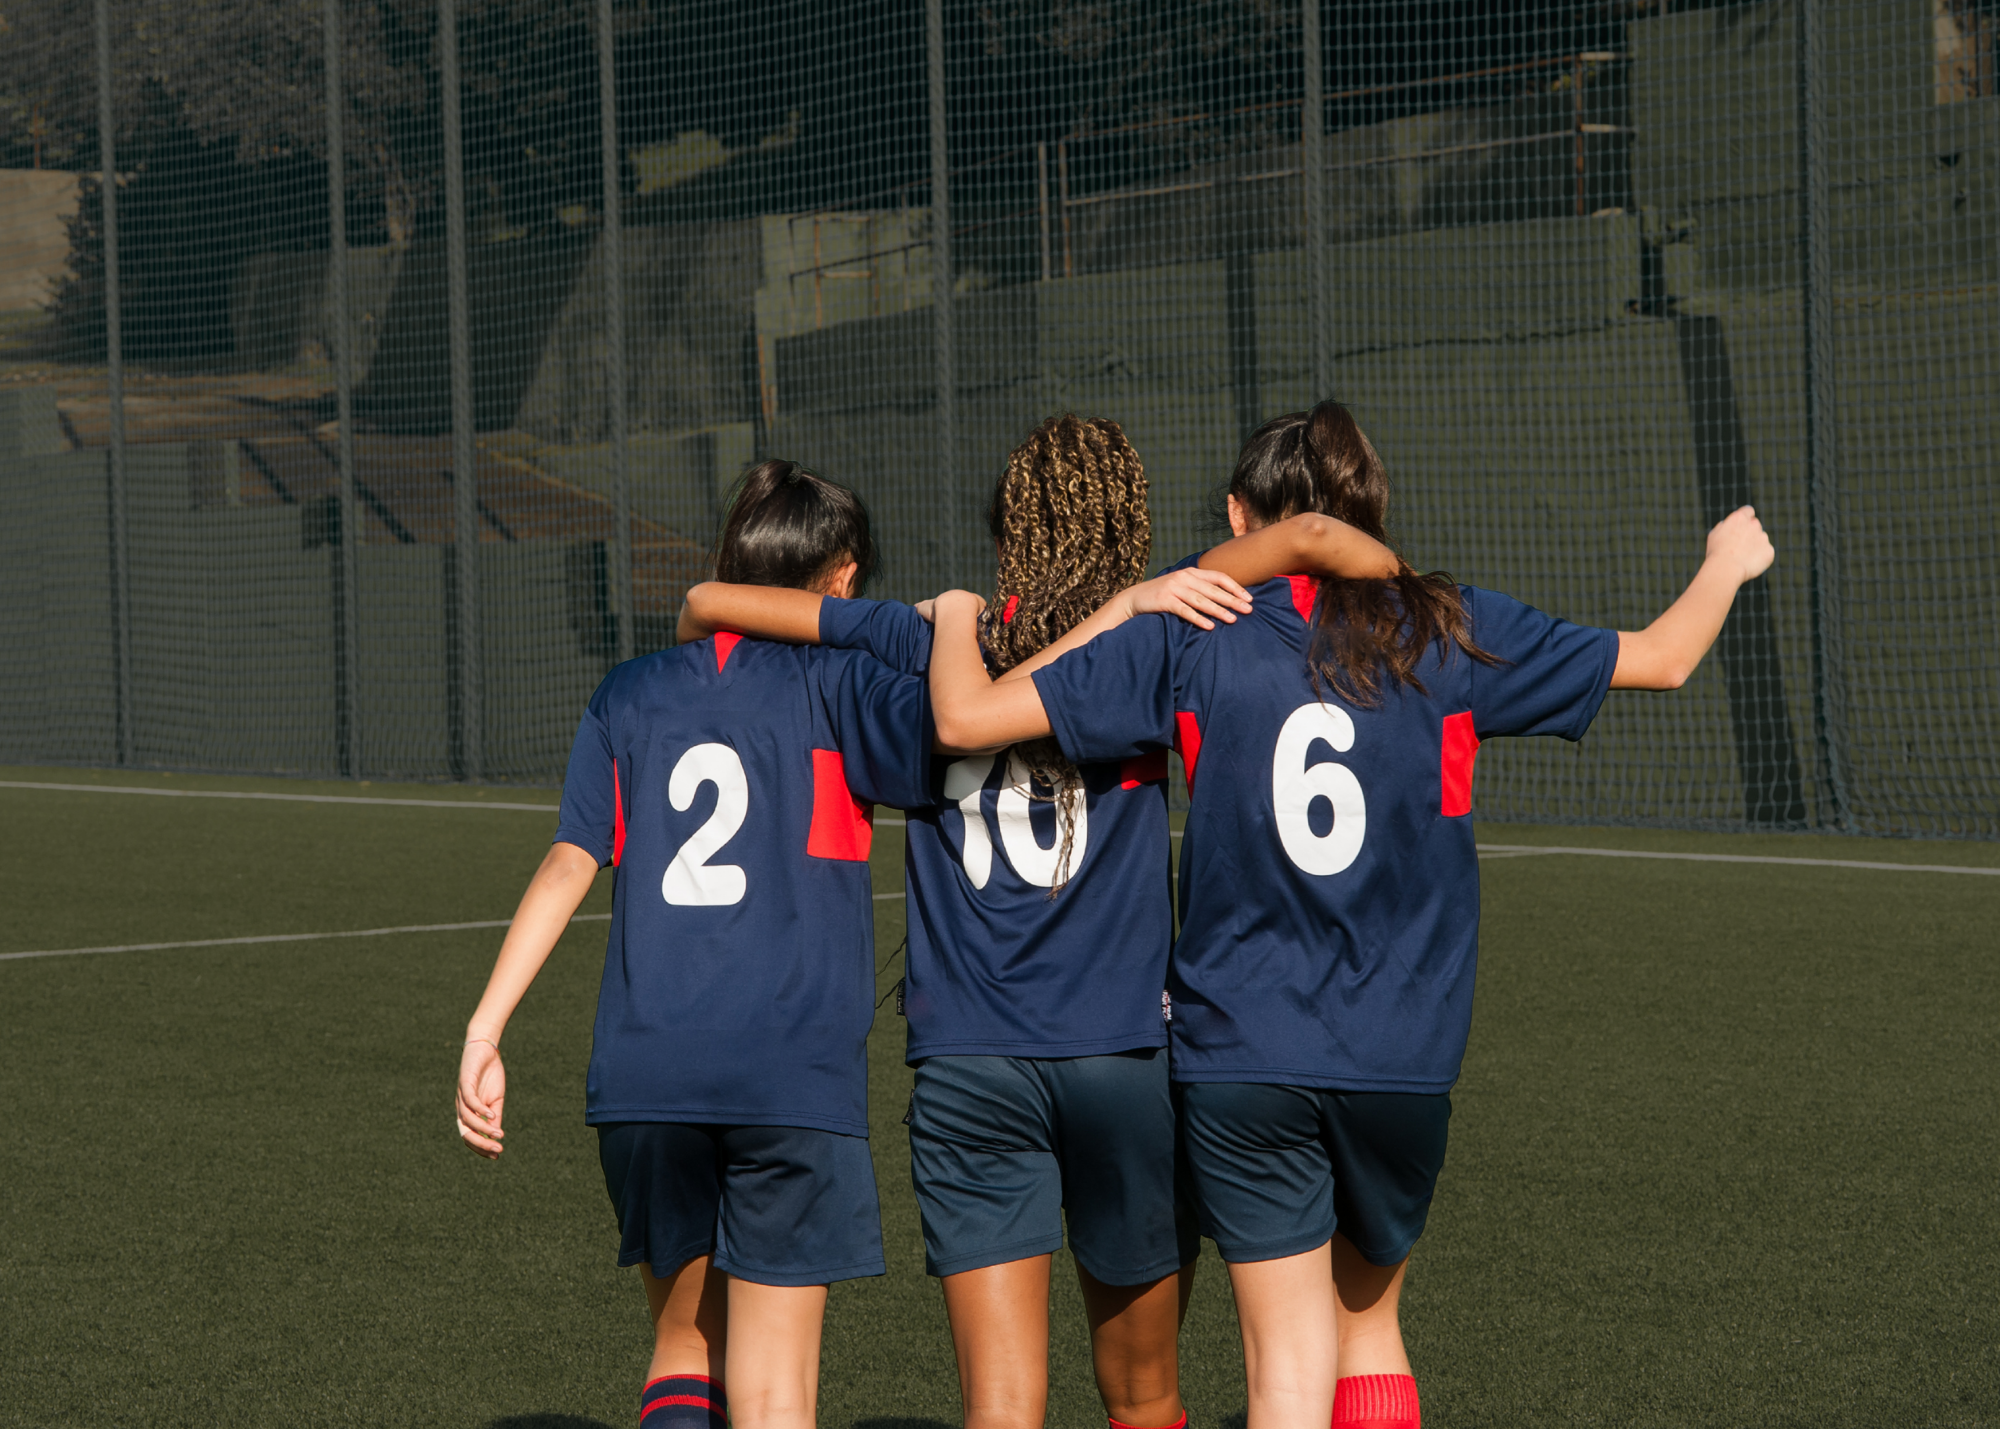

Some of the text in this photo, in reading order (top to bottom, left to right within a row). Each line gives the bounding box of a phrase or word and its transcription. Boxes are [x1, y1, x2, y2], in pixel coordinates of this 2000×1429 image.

[662, 743, 748, 906] 2
[944, 749, 1088, 890] 10
[1273, 702, 1367, 876] 6
